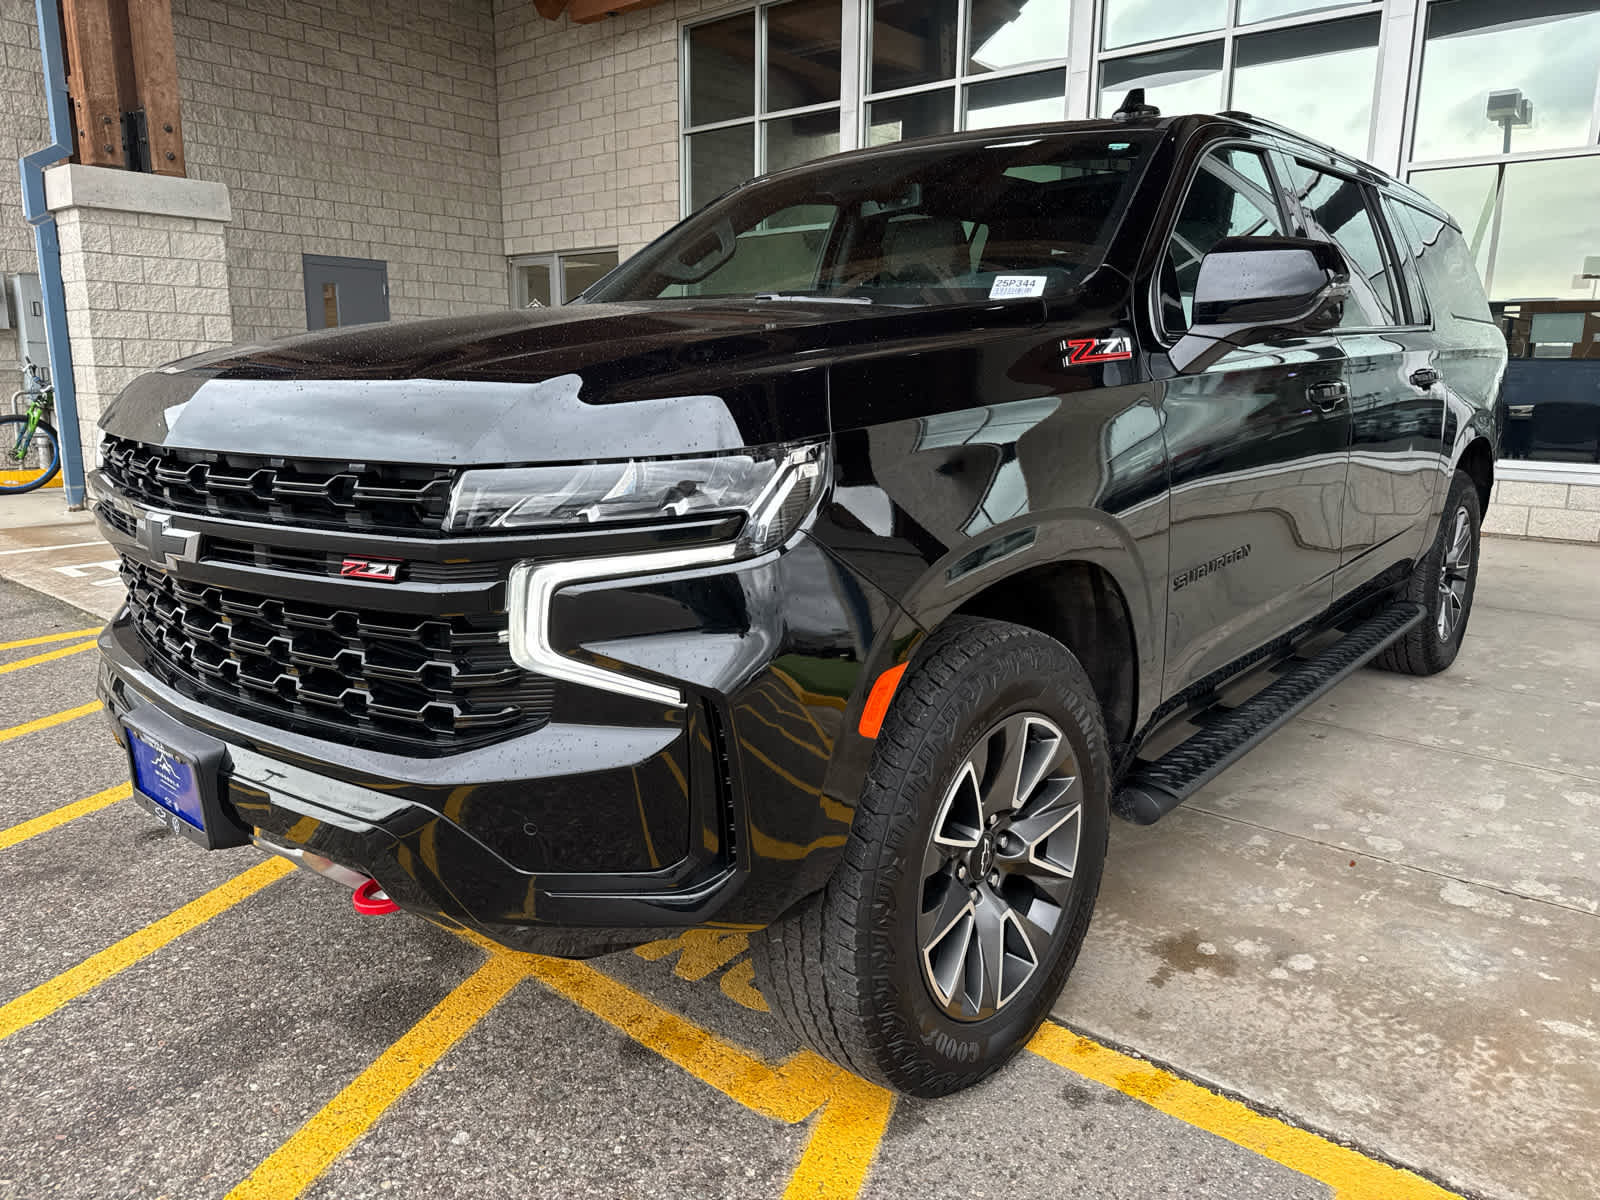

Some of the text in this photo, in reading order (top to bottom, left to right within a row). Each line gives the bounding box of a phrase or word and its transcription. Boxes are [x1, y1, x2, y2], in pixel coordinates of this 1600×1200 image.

[995, 279, 1036, 288] 25P344
[1066, 337, 1132, 364] Z71
[341, 559, 399, 581] Z71
[1173, 543, 1251, 592] SUBURBAN
